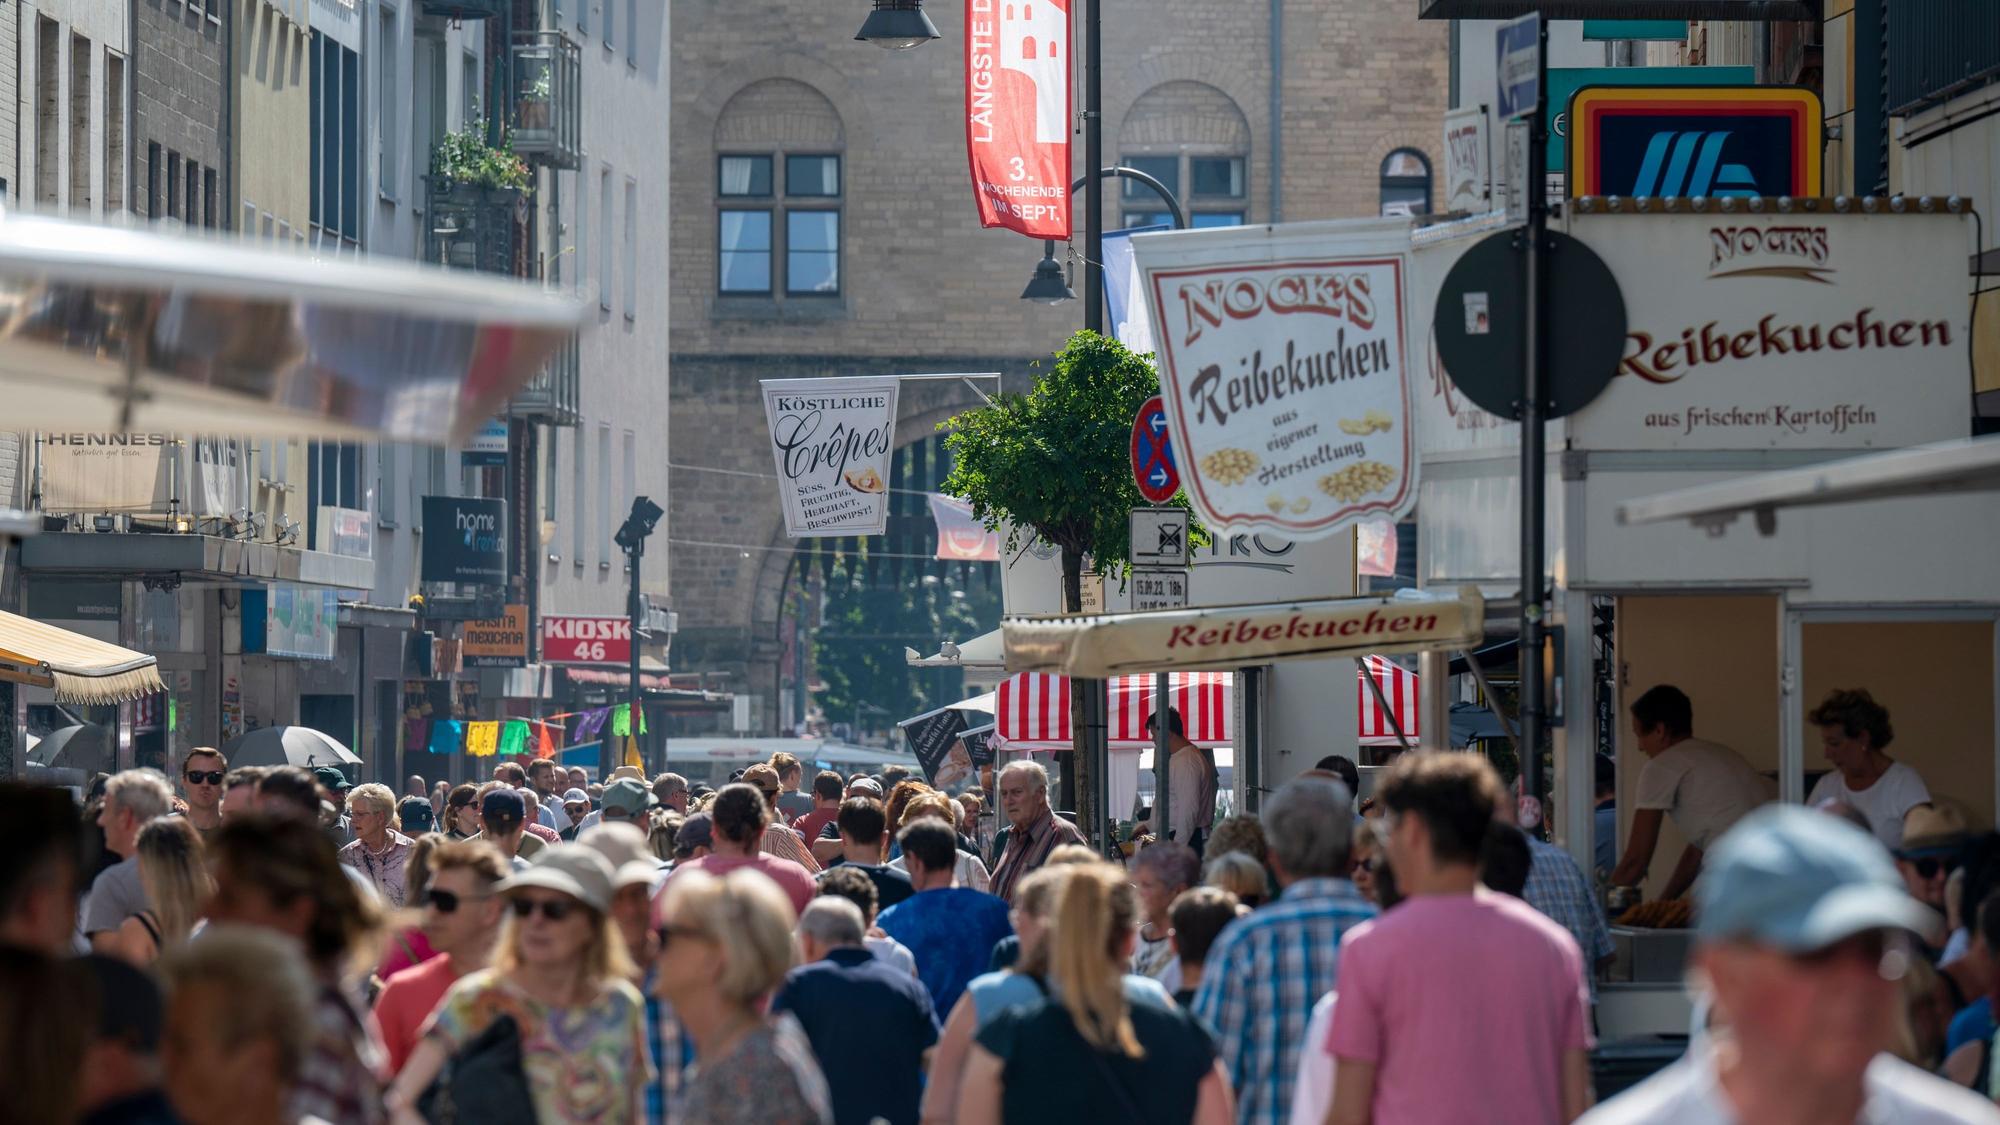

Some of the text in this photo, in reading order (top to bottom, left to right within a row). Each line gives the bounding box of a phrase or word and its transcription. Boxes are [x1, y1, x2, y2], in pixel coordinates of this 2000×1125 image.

[971, 21, 993, 142] LÄNGSTE
[1009, 156, 1034, 181] 3.
[979, 182, 1064, 198] WOCHENENDE
[992, 199, 1060, 222] IM SEPT.
[1613, 307, 1953, 384] Reibekuchen
[1189, 327, 1390, 426] Reibekuchen
[778, 396, 886, 411] KÖSTLICHE
[1272, 409, 1298, 426] aus
[1645, 404, 1877, 435] aus frischen Kartoffeln
[48, 432, 166, 446] HENNES
[774, 410, 890, 486] Crêpes
[1266, 424, 1319, 451] eigener
[1257, 440, 1366, 486] Herstellung
[797, 484, 827, 496] SÜSS,
[800, 488, 852, 508] FRUCHTIG,
[456, 507, 495, 530] home
[804, 498, 860, 519] HERZHAFT,
[807, 505, 873, 530] BESCHWIPST!
[466, 630, 524, 645] MEXICANA
[545, 619, 631, 641] KIOSK
[1167, 609, 1439, 649] Reibekuchen
[574, 641, 606, 660] 46
